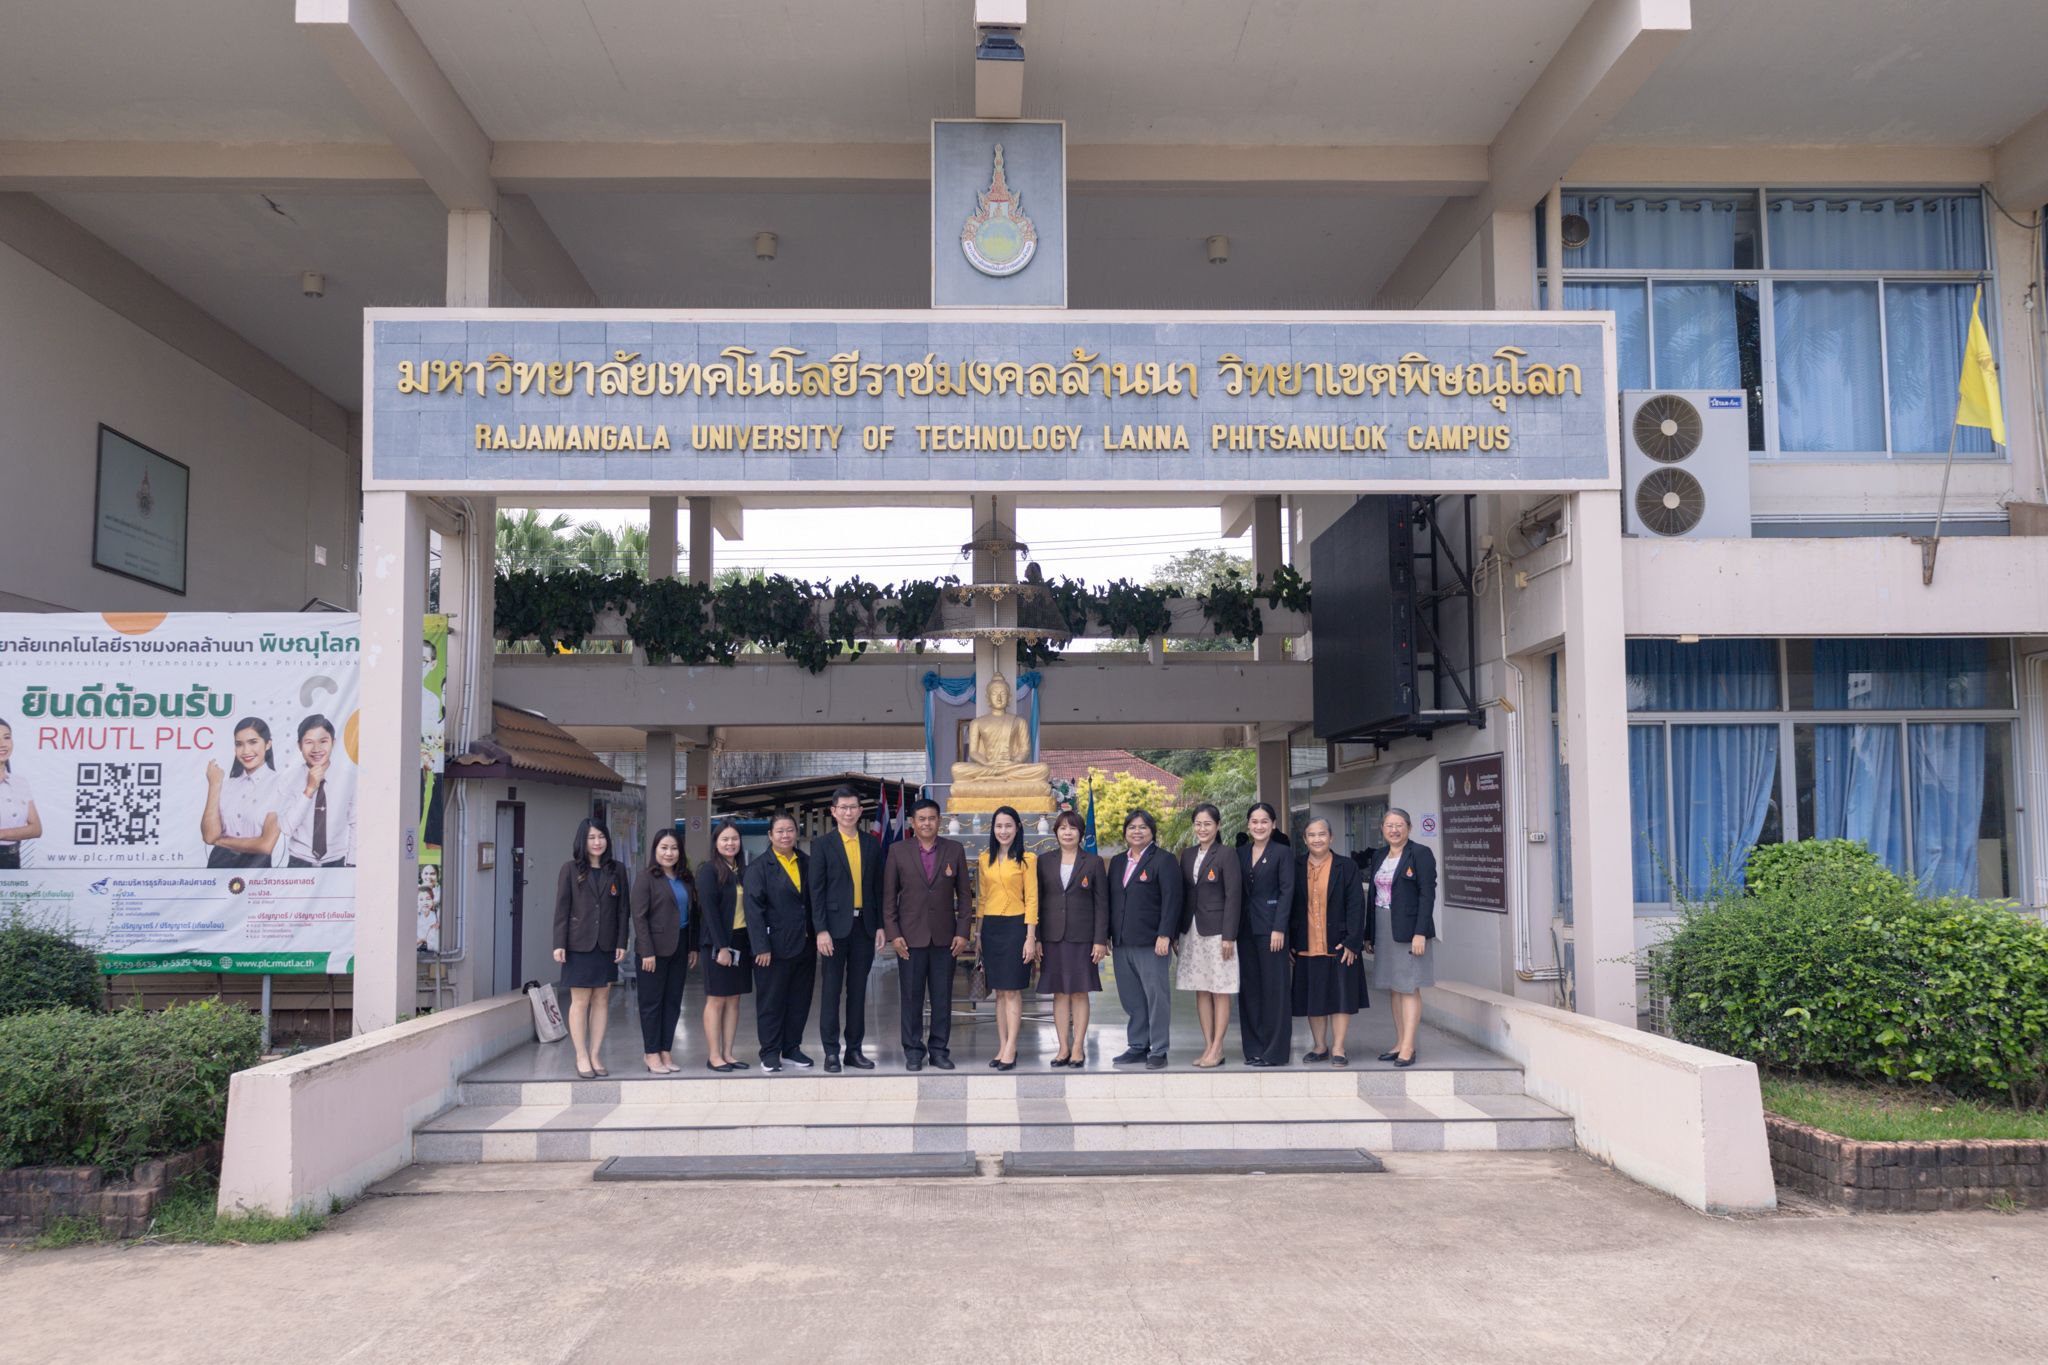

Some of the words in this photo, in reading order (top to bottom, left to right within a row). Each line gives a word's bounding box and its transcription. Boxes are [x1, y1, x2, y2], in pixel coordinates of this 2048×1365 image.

[398, 346, 1197, 398] มหาวิทยาลัยเทคโนโลยีราชมงคลล้านนา
[1217, 346, 1582, 412] วิทยาเขตพิษณุโลก
[475, 424, 670, 451] RAJAMANGALA
[691, 424, 843, 450] UNIVERSITY
[863, 425, 894, 450] OF
[916, 424, 1082, 451] TECHNOLOGY
[1103, 425, 1190, 450] LANNA
[1211, 424, 1388, 452] PHITSANULOK
[1407, 425, 1511, 450] CAMPUS
[259, 631, 360, 659] พิษณุโลก
[36, 659, 110, 668] University
[142, 659, 218, 668] Technology
[229, 659, 267, 667] Lanna
[21, 682, 235, 719] ยินดีต้อนรับ
[38, 726, 145, 751] RMUTL
[155, 726, 215, 751] PLC
[47, 851, 185, 864] www.plc.rmutl.ac.th
[235, 959, 315, 969] www.plc.rmutl.ac.th
